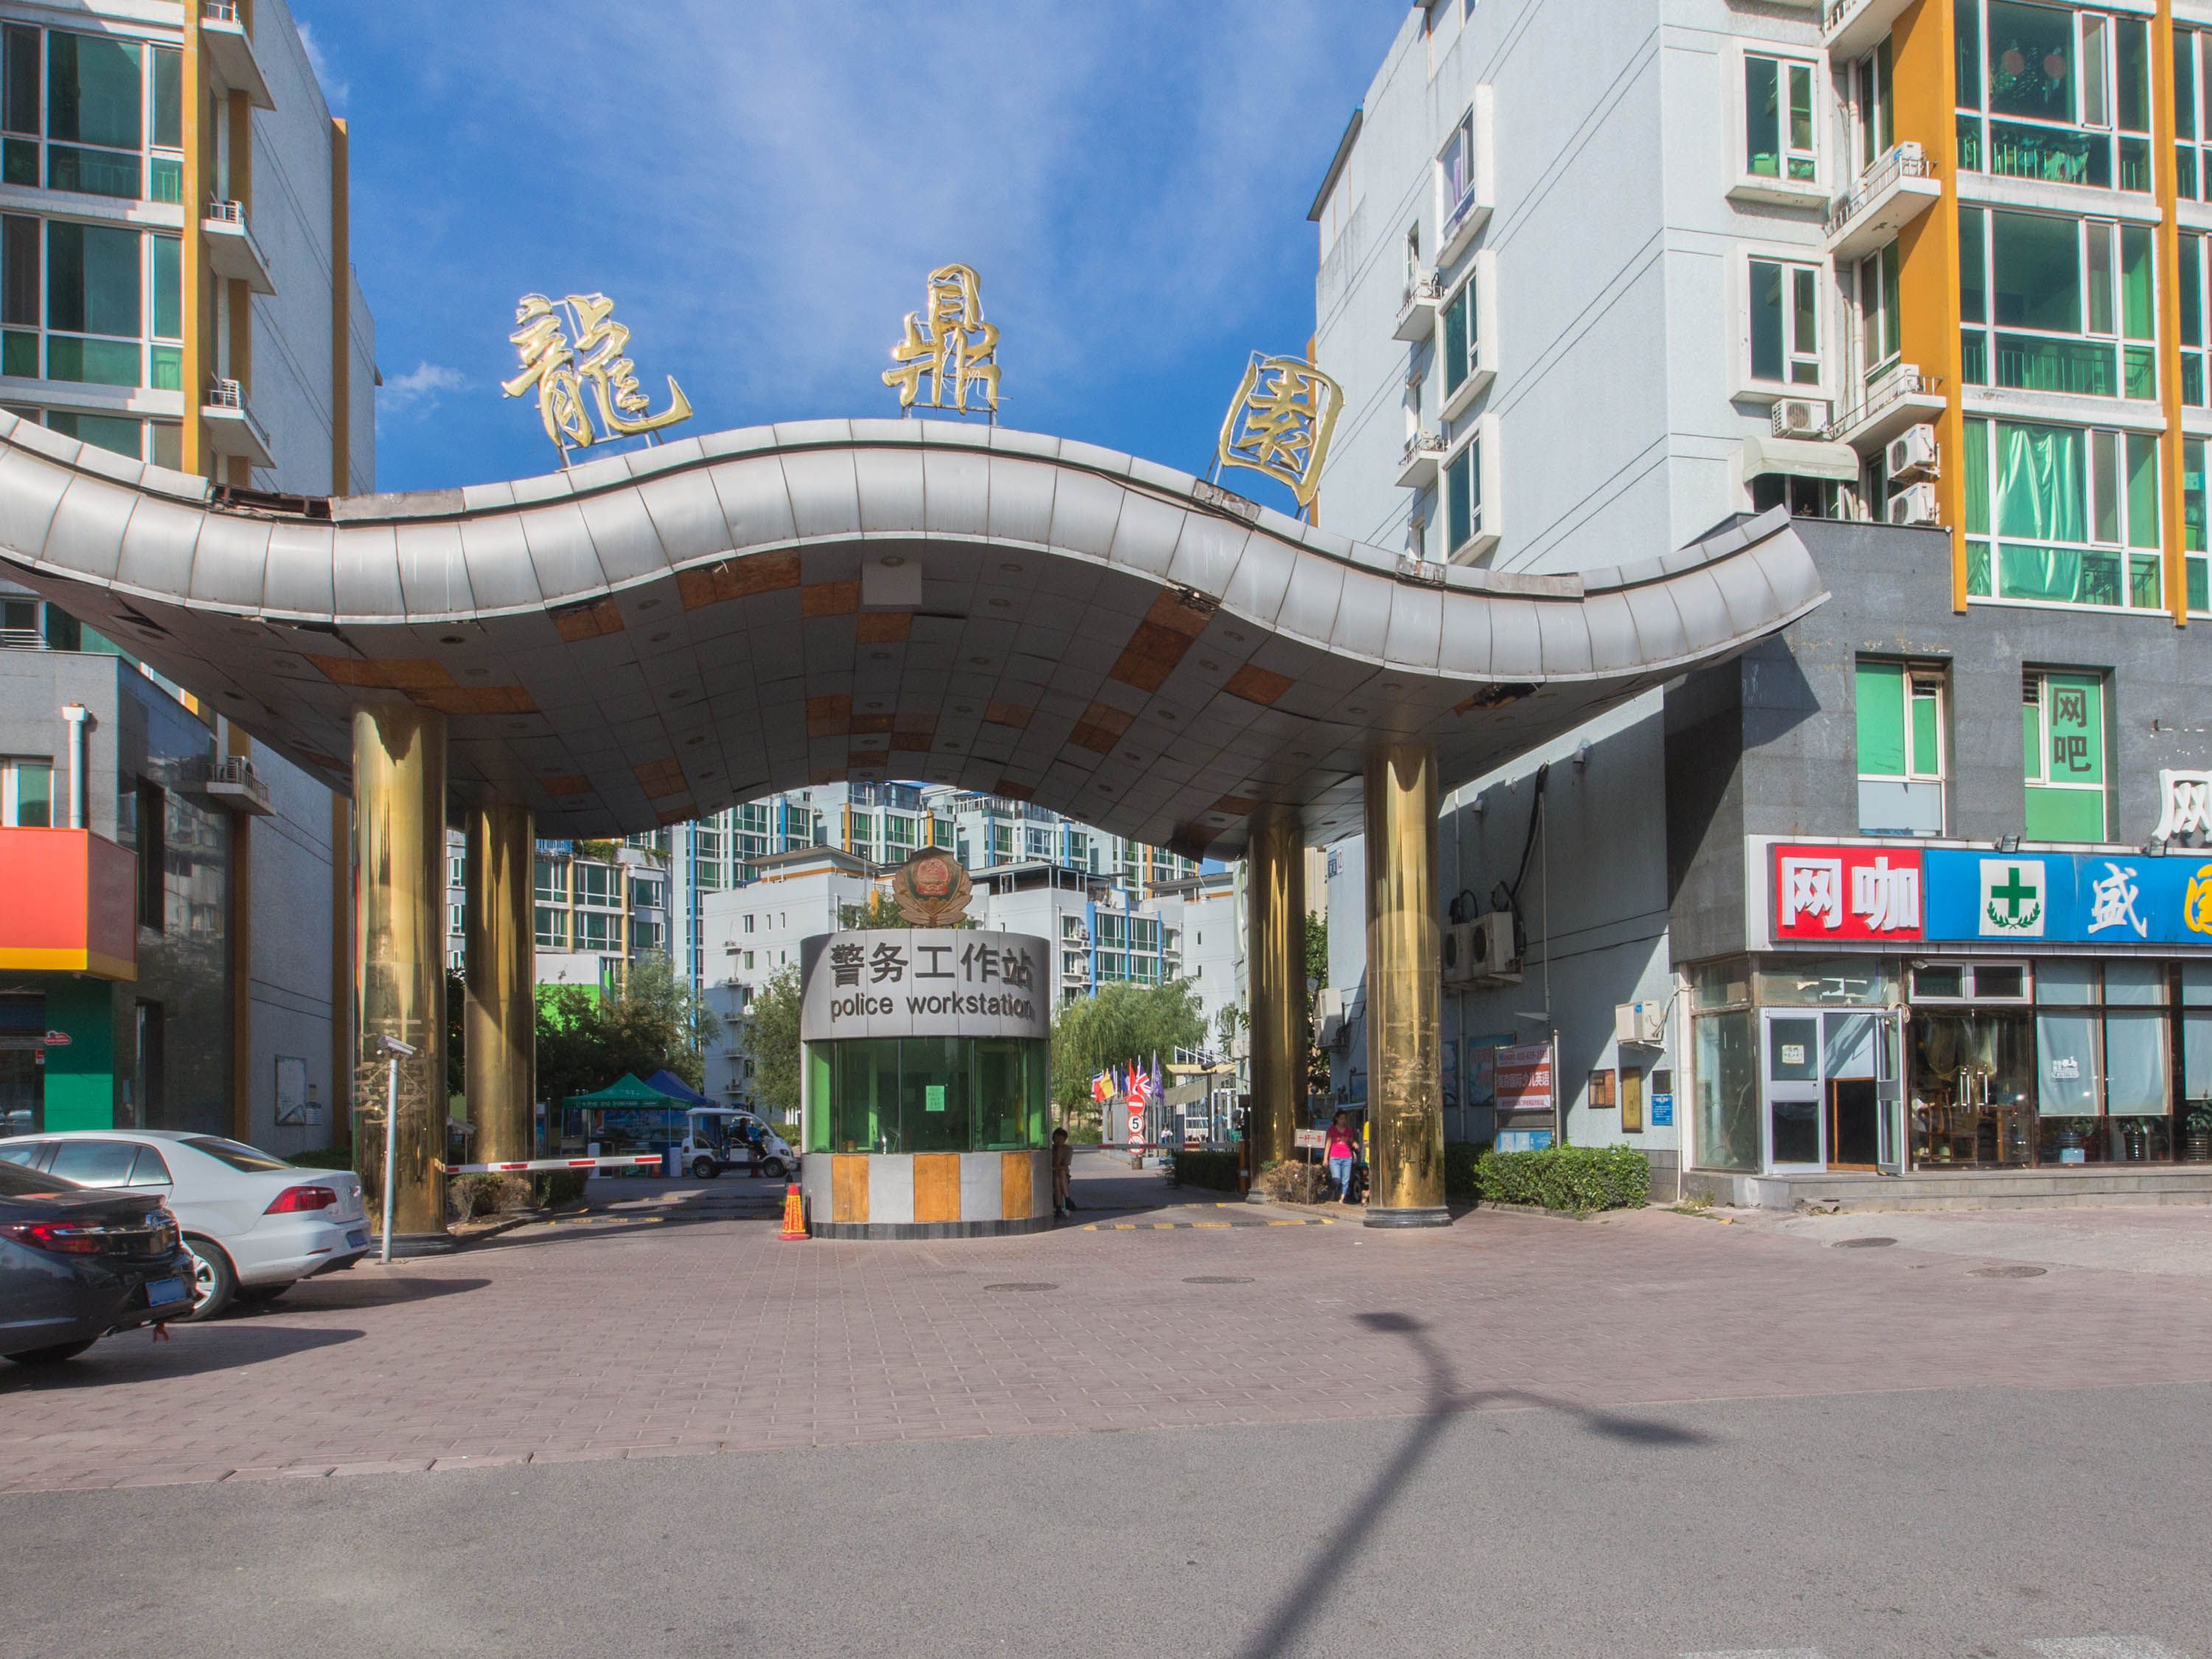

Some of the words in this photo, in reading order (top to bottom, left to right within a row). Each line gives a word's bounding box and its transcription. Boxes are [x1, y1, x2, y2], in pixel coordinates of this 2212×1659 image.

[2053, 687, 2091, 772] 网吧
[2152, 769, 2212, 845] 网
[1781, 857, 1920, 931] 网咖
[830, 942, 1033, 992] 警务工作站
[831, 992, 894, 1023] police
[906, 991, 1034, 1023] workstation
[1132, 1118, 1139, 1130] 5
